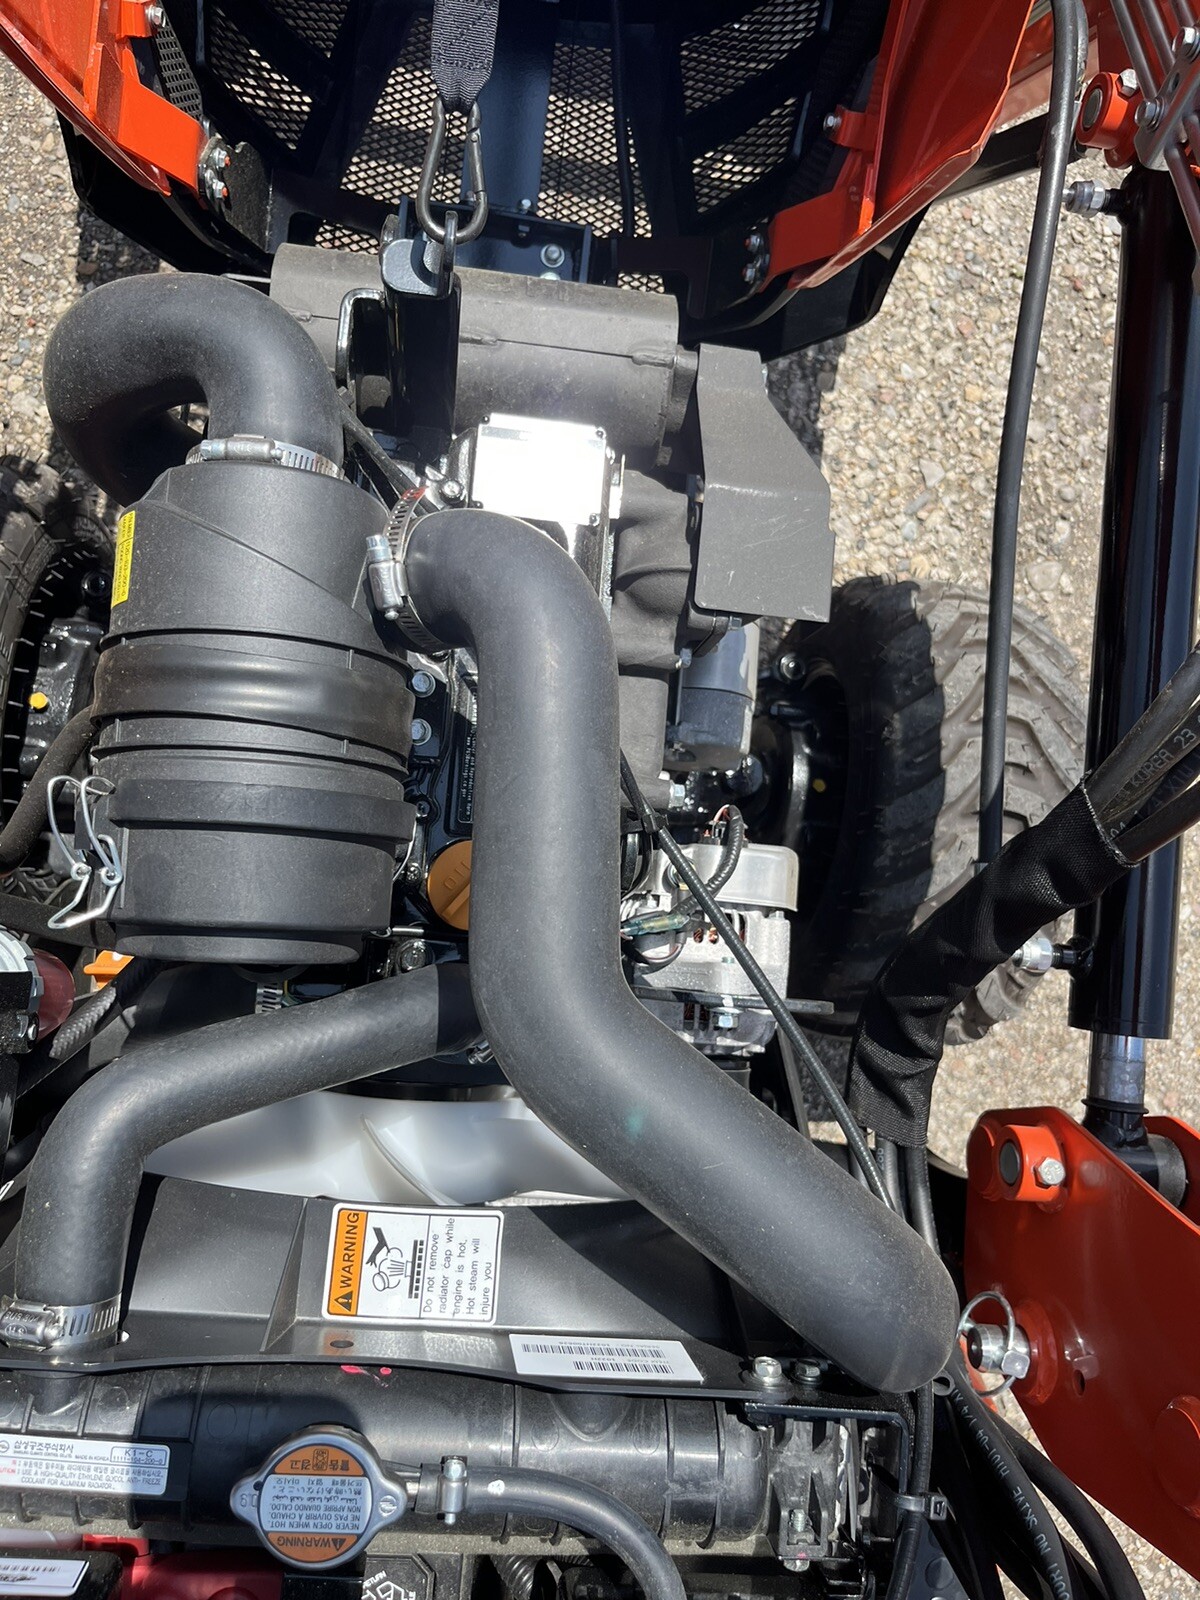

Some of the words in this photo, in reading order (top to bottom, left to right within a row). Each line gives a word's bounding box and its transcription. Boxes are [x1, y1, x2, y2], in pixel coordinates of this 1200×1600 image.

[1129, 748, 1175, 788] KOREA
[1174, 728, 1197, 749] 23
[445, 1217, 456, 1244] while
[340, 1212, 360, 1289] WARNING
[429, 1233, 440, 1270] remove
[472, 1237, 481, 1254] will
[444, 1249, 453, 1269] cap
[457, 1264, 465, 1273] is
[484, 1261, 494, 1281] you
[469, 1260, 479, 1292] steam
[427, 1276, 435, 1293] not
[439, 1275, 449, 1314] radiator
[453, 1279, 464, 1315] engine
[480, 1286, 491, 1316] injure
[423, 1299, 433, 1313] Do
[466, 1297, 476, 1315] Hot
[124, 1449, 154, 1458] K1-C
[290, 1459, 312, 1472] 경고
[329, 1459, 350, 1471] 警告
[21, 1477, 46, 1485] COOLANT
[59, 1480, 86, 1488] ALUMINUM
[40, 1471, 76, 1480] HIGH-QUALITY
[77, 1473, 104, 1482] ETHYLENE
[105, 1475, 125, 1483] GLYCOL
[142, 1478, 161, 1486] FREEZE
[294, 1504, 321, 1512] QUANDO
[324, 1504, 347, 1513] APRIRE
[347, 1504, 362, 1513] NON
[1012, 1486, 1038, 1531] SKIVE
[305, 1513, 332, 1521] OUVRIR
[334, 1514, 349, 1522] PAS
[350, 1514, 360, 1522] NE
[267, 1520, 286, 1529] HOT.
[288, 1521, 310, 1530] WHEN
[312, 1521, 333, 1530] OPEN
[335, 1522, 361, 1530] NEVER
[276, 1536, 332, 1548] WARNING
[1034, 1533, 1052, 1556] NO
